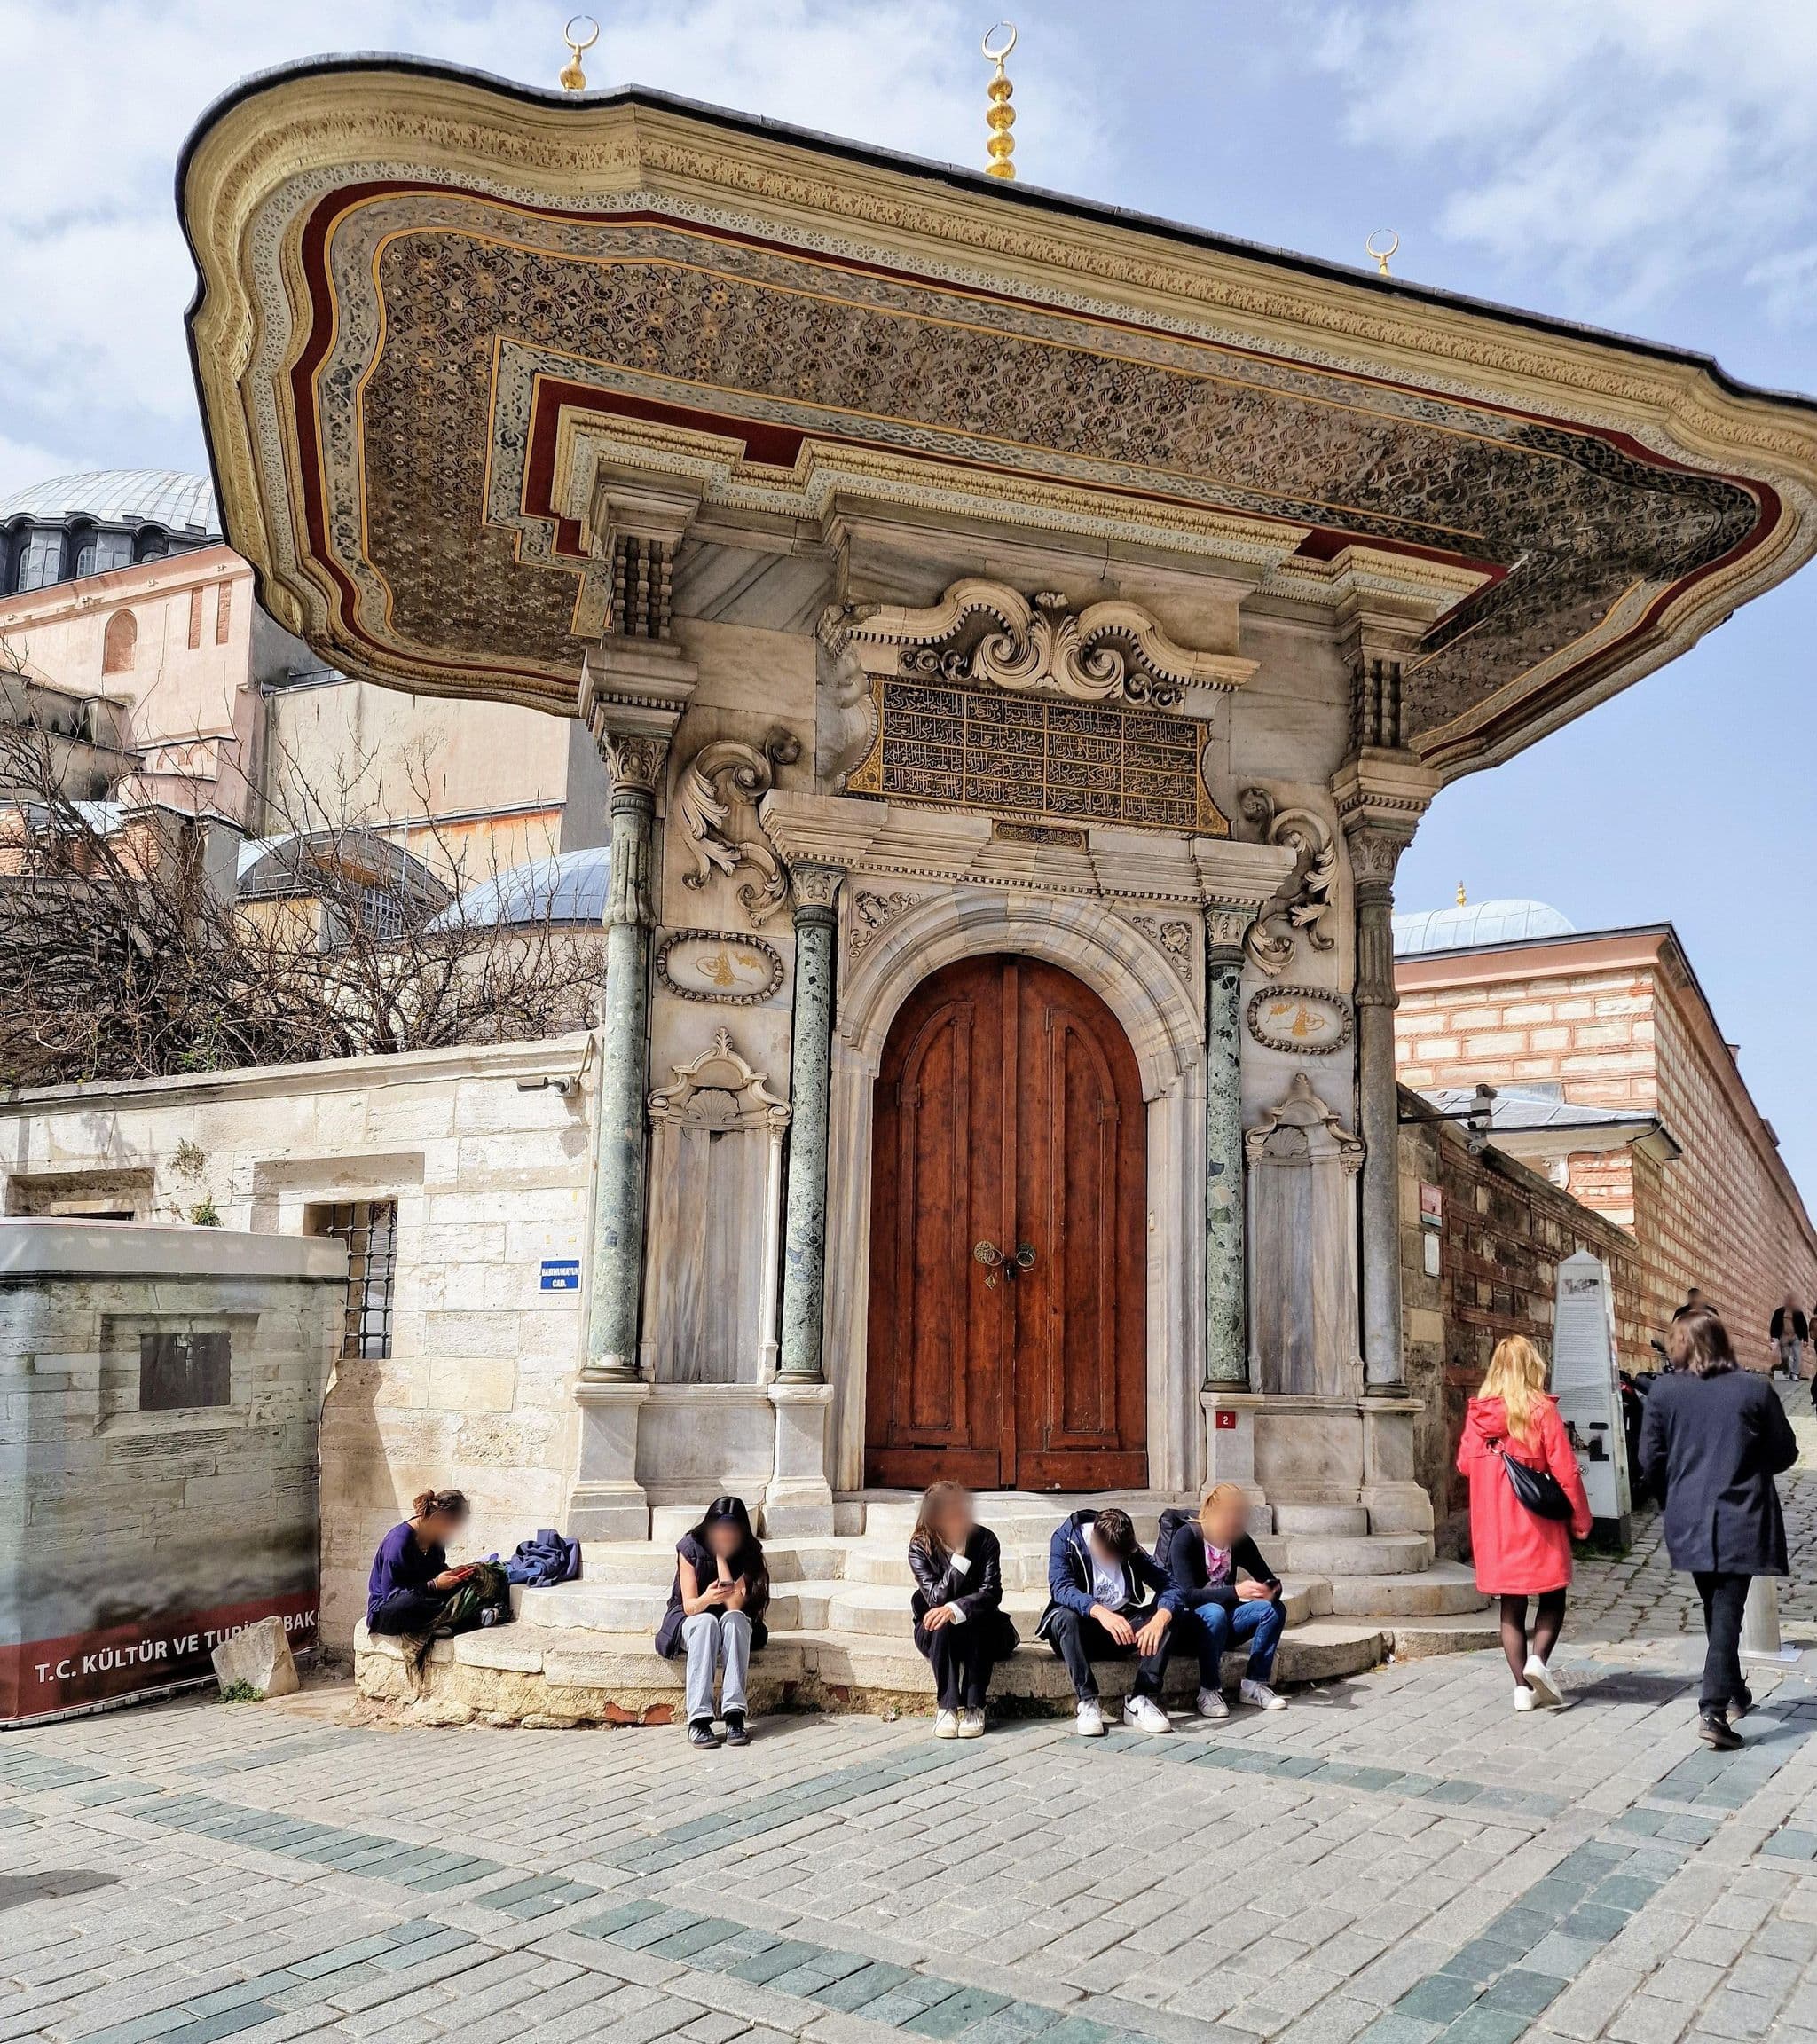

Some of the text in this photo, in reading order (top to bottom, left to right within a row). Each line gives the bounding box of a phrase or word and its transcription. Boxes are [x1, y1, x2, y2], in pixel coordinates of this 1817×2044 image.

[1223, 1415, 1229, 1425] 2
[35, 1659, 77, 1683] T.C.
[83, 1639, 168, 1674] KÜLTÜR
[173, 1634, 199, 1655] VE
